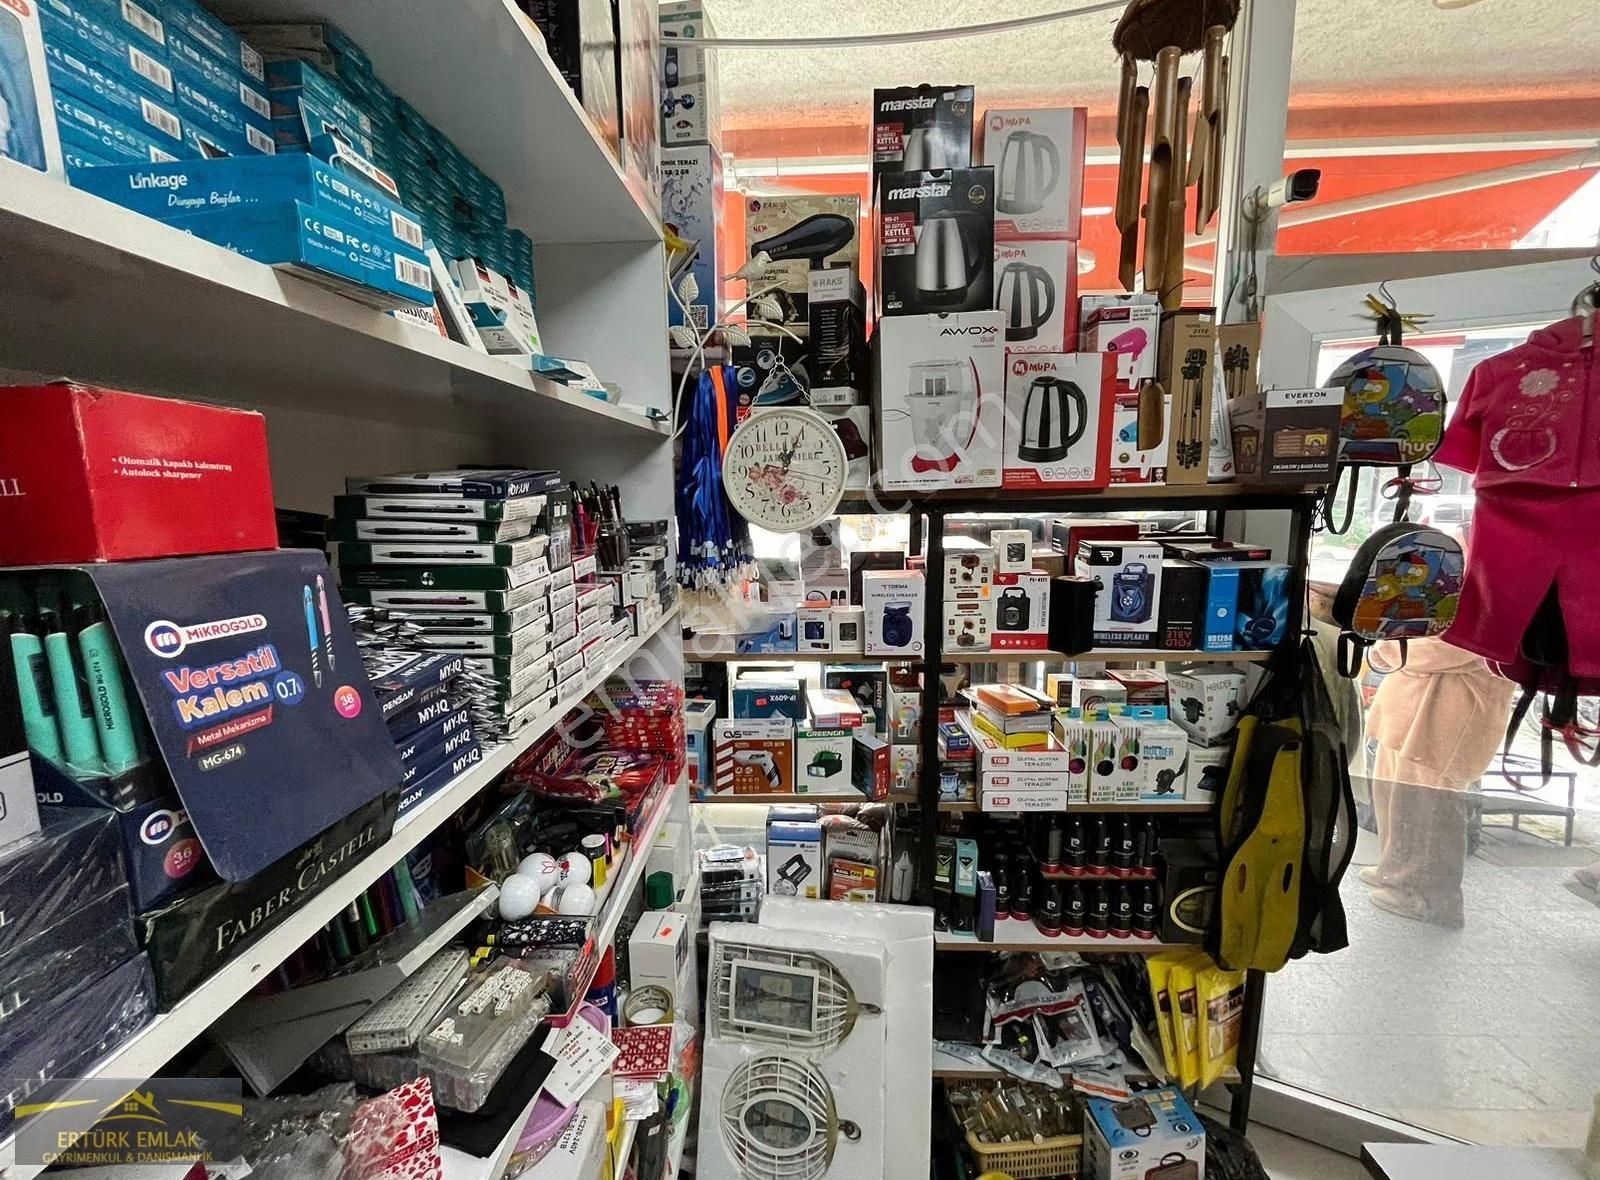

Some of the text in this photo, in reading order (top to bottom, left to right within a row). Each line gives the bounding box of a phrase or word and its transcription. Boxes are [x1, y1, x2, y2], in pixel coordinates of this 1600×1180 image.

[880, 96, 936, 112] marsstar
[130, 172, 188, 190] Linkage
[888, 182, 952, 200] marsstar
[885, 228, 910, 236] KETTLE
[820, 277, 842, 286] RAKS
[940, 326, 993, 336] AWOX
[118, 456, 161, 466] Otomatik
[121, 468, 161, 477] Autolock
[1093, 632, 1149, 641] WIRELESS SPEAKER
[166, 646, 277, 694] Versatil
[439, 658, 463, 682] MY-IQ
[176, 681, 269, 722] Kalem
[382, 688, 415, 712] PENSAN
[418, 698, 450, 724] MY-IQ
[197, 713, 267, 745] Metal Mekanizma
[443, 709, 469, 735] MY-IQ
[445, 728, 471, 755] MY-IQ
[723, 730, 742, 739] CVS
[202, 746, 242, 770] MG-674
[400, 745, 416, 760] AN
[453, 747, 480, 775] MY-IQ
[403, 766, 416, 782] AN
[38, 792, 64, 804] OLD
[173, 846, 192, 863] 36
[214, 826, 376, 954] FABER-CASTELL
